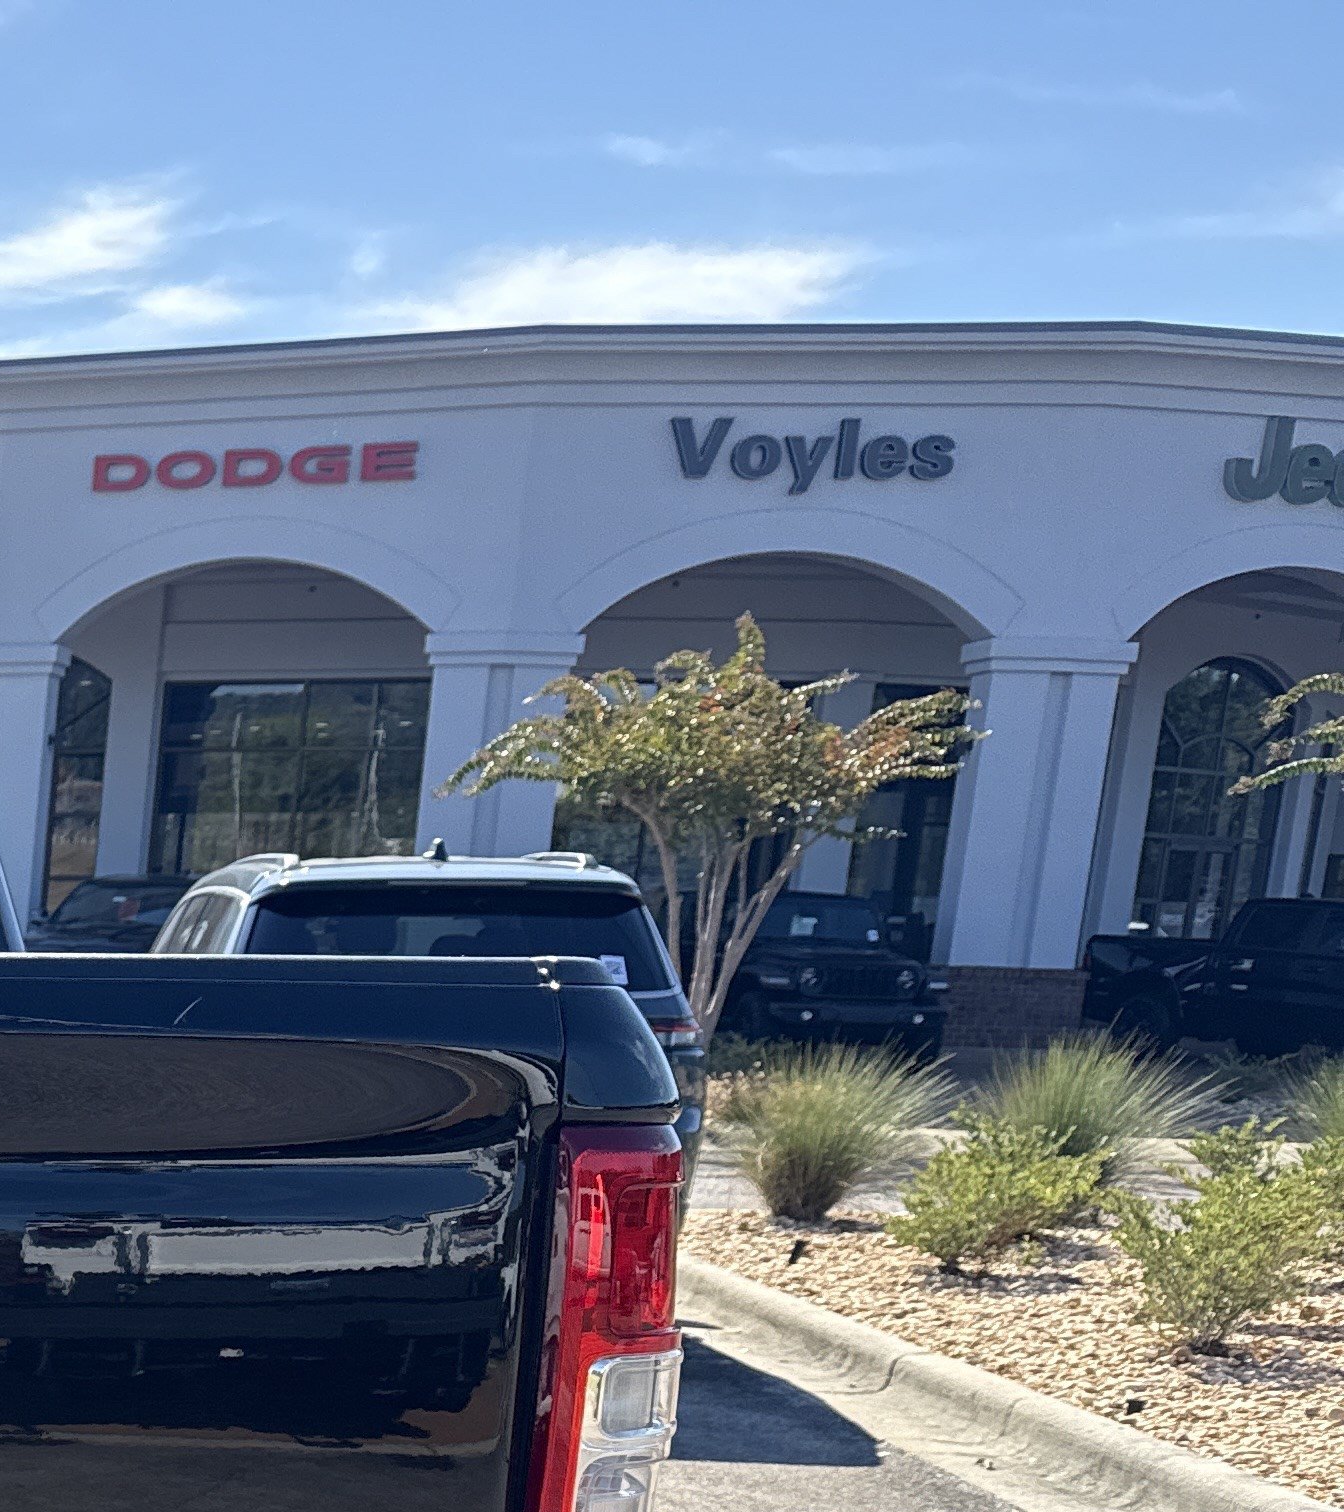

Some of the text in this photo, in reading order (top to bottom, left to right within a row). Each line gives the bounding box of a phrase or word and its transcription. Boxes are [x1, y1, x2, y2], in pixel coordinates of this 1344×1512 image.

[91, 440, 419, 493] DODGE
[670, 416, 957, 495] Voyles
[1223, 416, 1344, 507] Je
